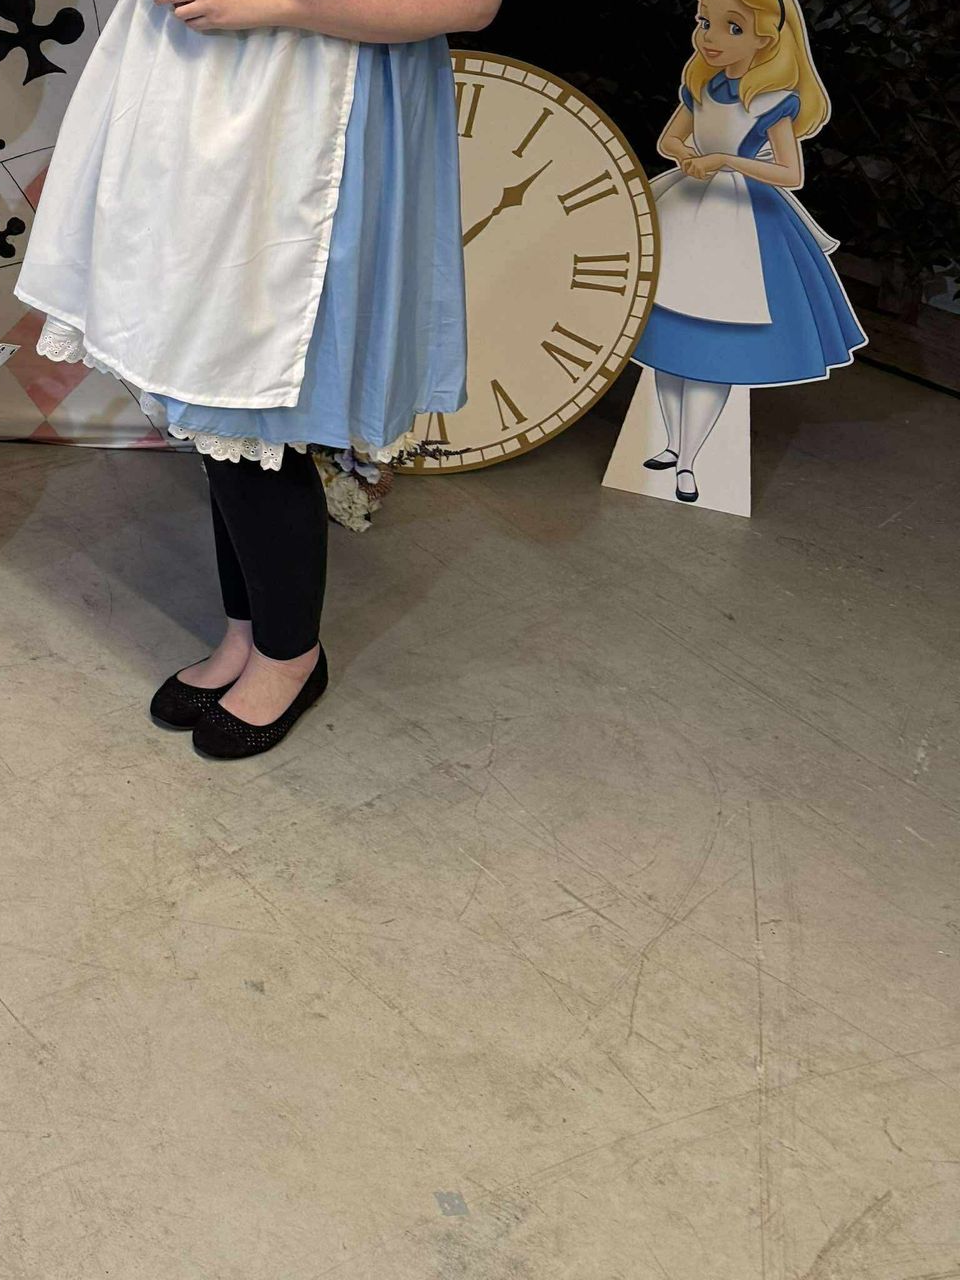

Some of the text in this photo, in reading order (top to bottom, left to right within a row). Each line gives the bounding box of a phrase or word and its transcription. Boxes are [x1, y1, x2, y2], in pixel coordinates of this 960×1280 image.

[512, 107, 554, 158] I
[557, 169, 619, 216] II
[571, 251, 630, 296] III
[541, 322, 604, 384] IV
[490, 379, 528, 431] V
